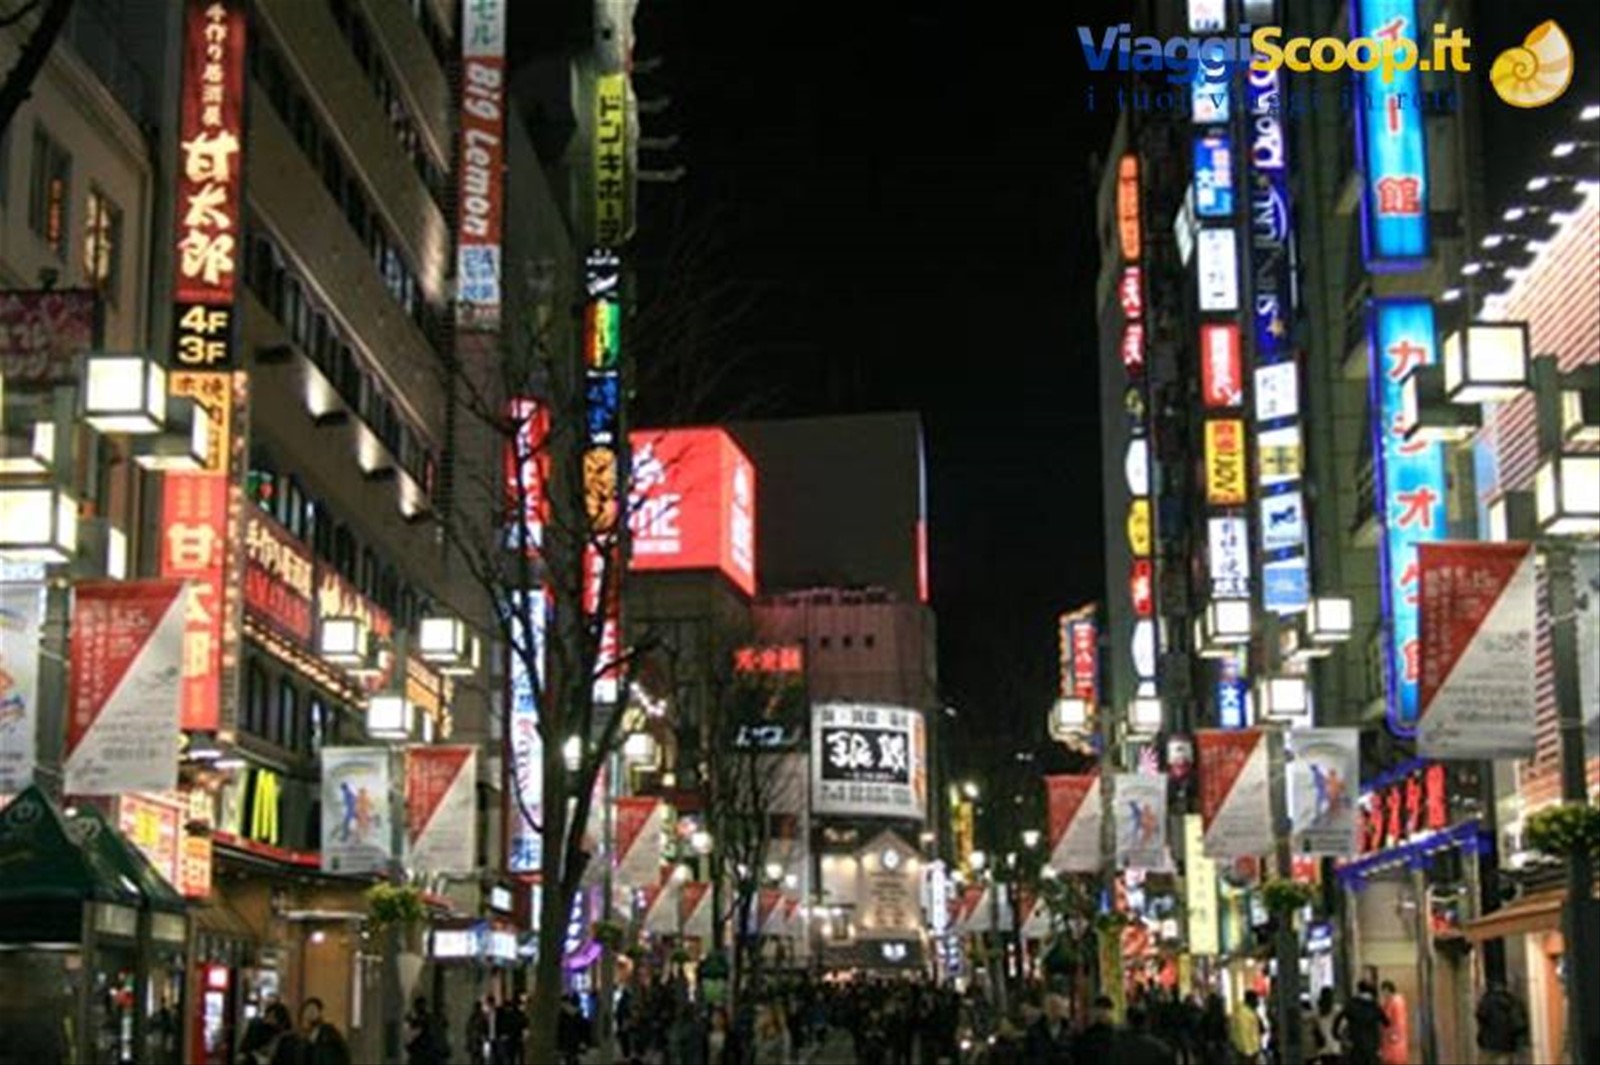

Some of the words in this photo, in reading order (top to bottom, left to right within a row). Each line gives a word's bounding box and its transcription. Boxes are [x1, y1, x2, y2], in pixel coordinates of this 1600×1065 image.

[464, 62, 501, 120] Big
[177, 129, 240, 285] 甘太郎
[463, 129, 498, 237] Lemon
[179, 305, 228, 333] 4F
[177, 335, 227, 364] 3F
